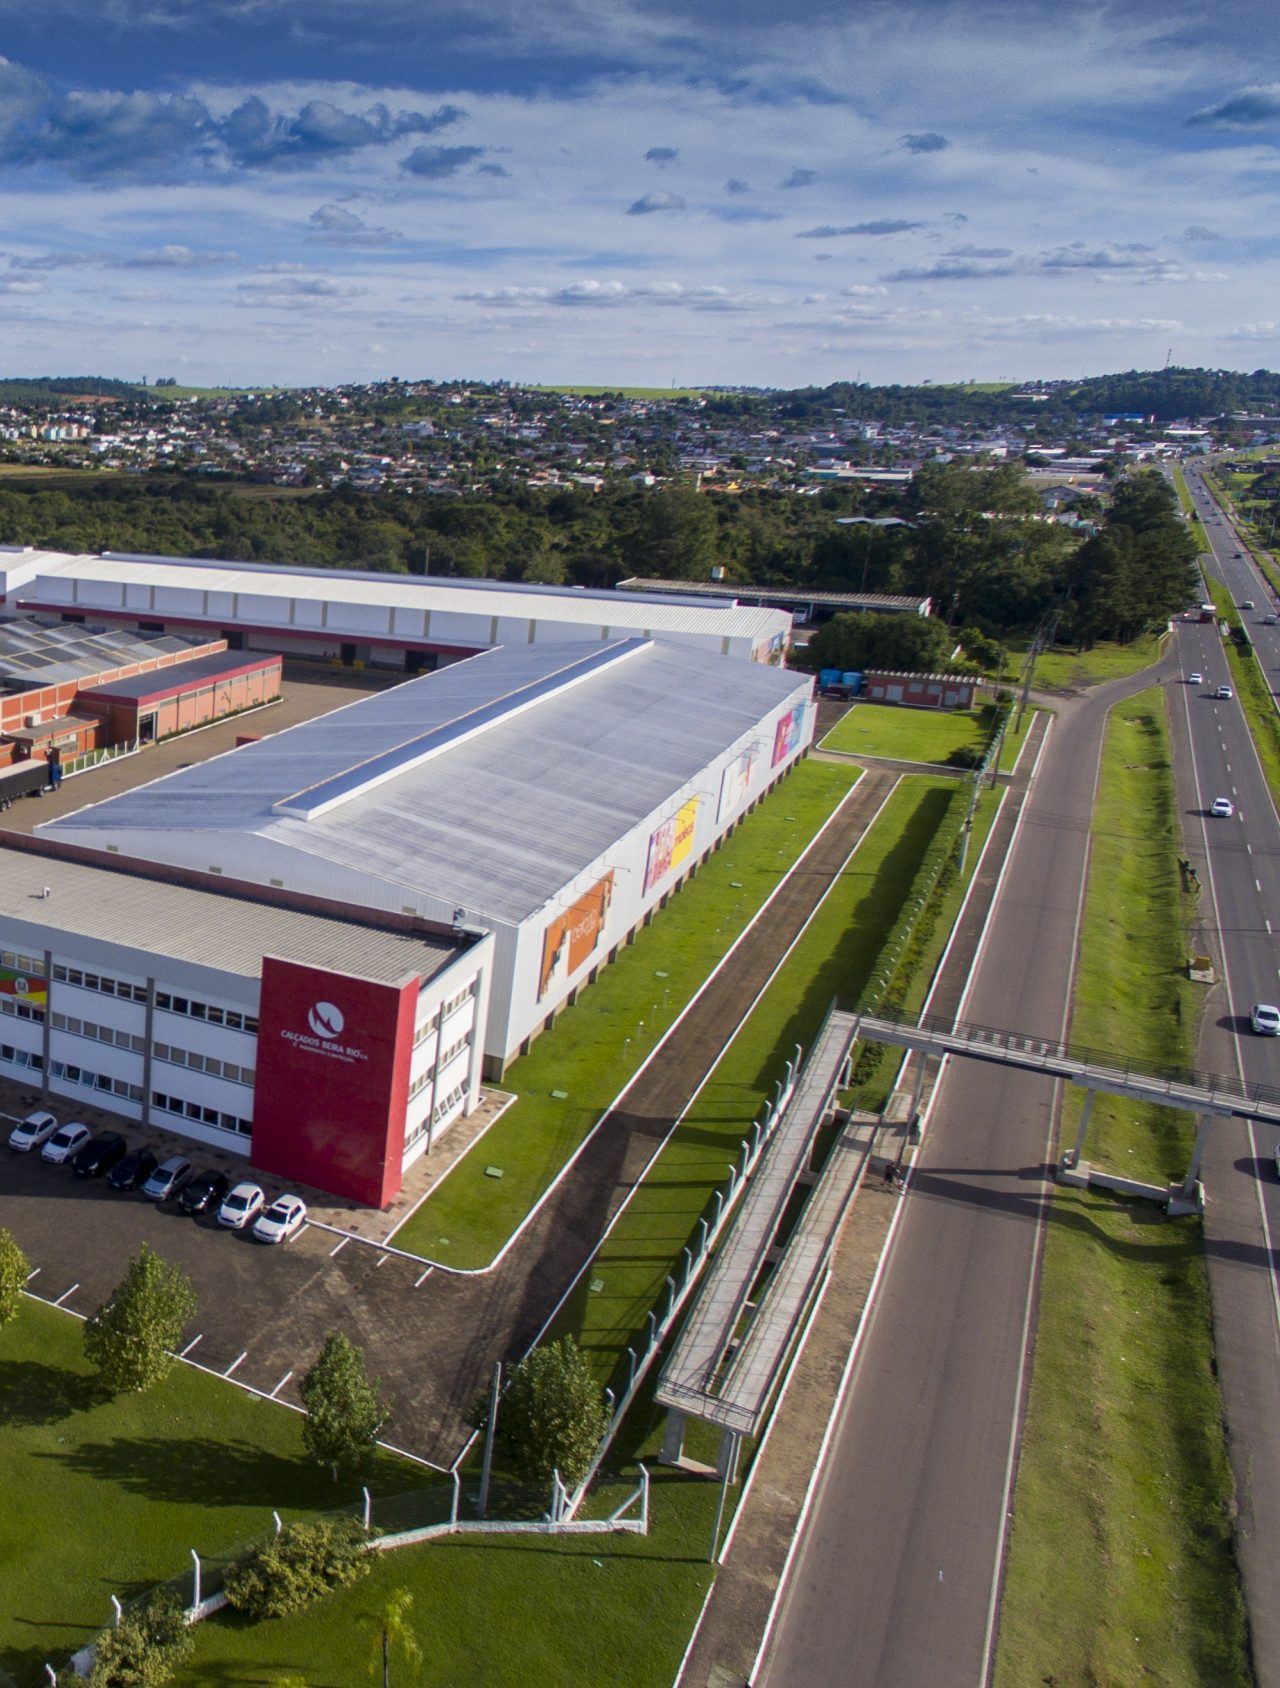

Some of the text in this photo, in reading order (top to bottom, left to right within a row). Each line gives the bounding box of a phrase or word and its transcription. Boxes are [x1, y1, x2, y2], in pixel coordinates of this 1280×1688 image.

[281, 1030, 320, 1046] CALÇADOS
[322, 1041, 344, 1053] BEIRA
[347, 1047, 360, 1057] RIO
